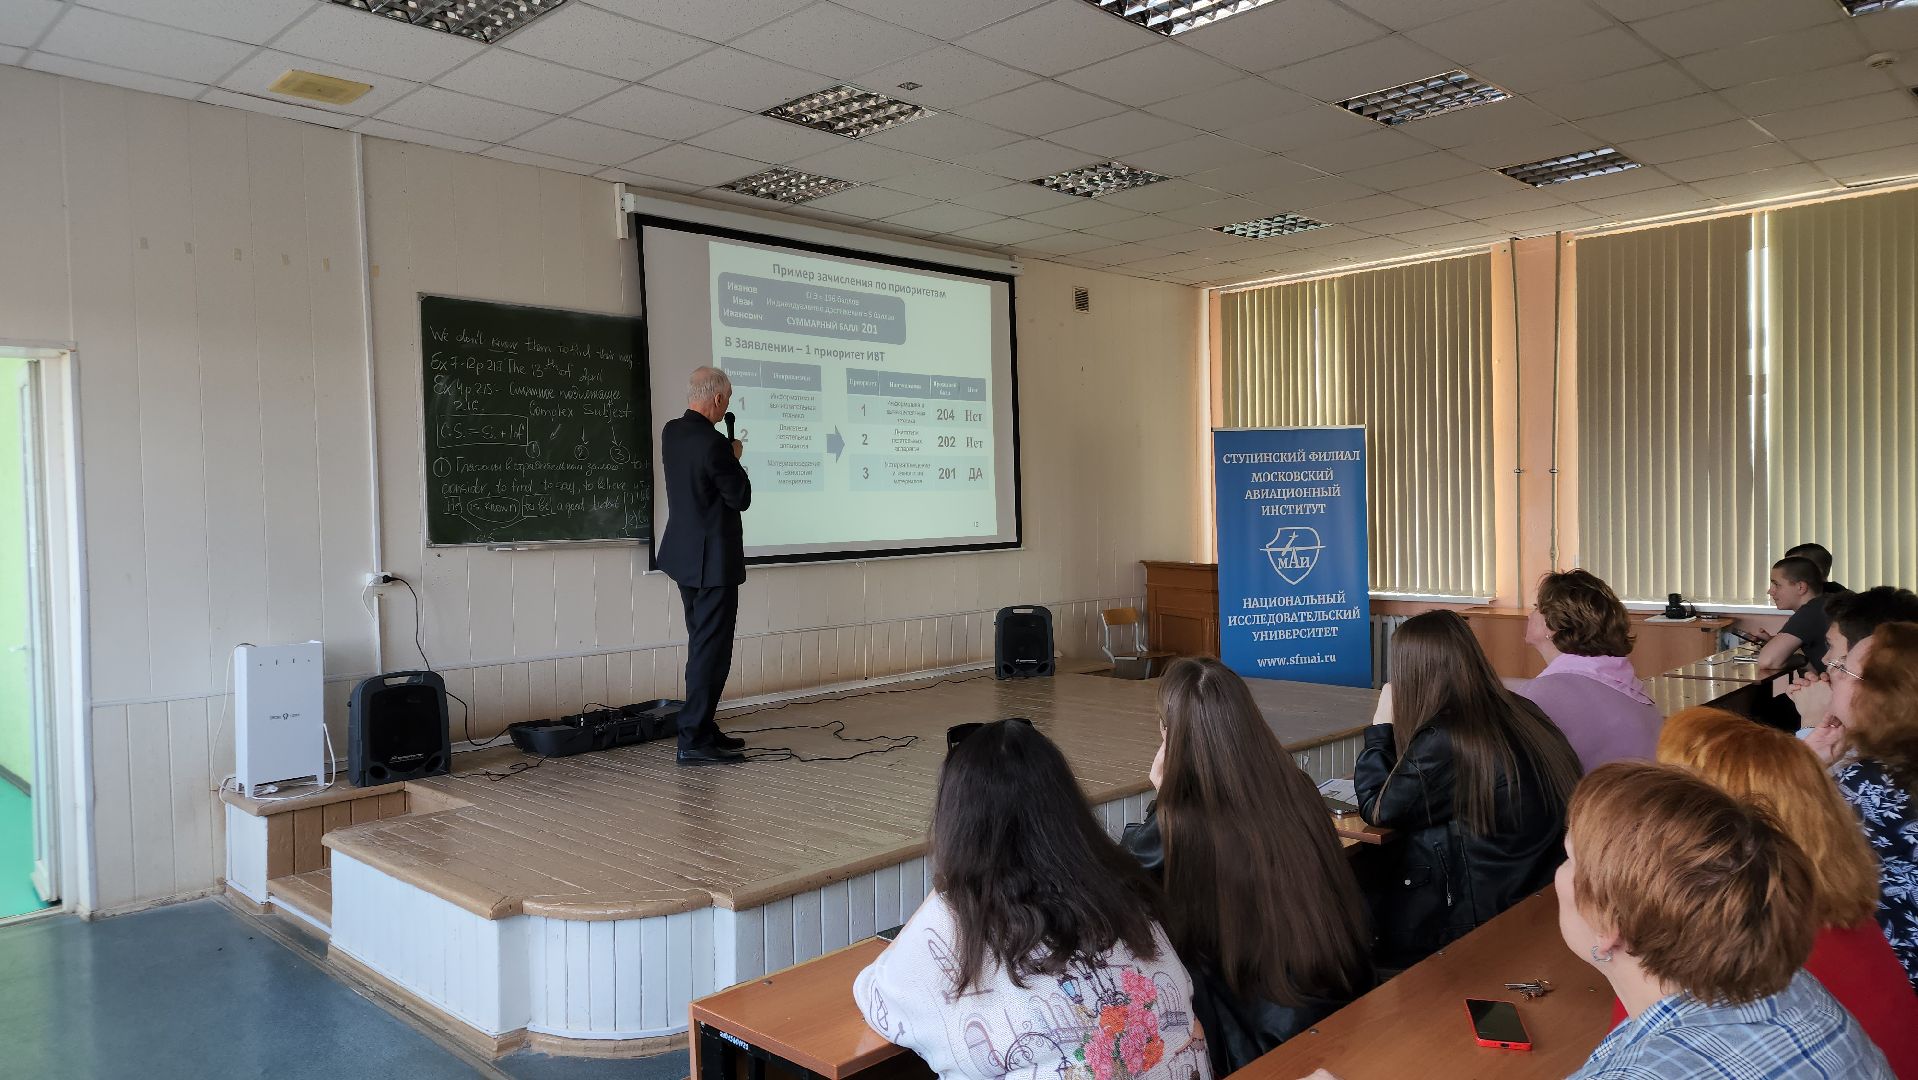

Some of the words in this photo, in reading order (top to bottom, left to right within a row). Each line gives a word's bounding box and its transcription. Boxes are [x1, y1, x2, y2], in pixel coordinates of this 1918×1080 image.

[727, 281, 758, 294] Иванов
[772, 263, 815, 281] Пример
[817, 272, 873, 289] зачисления
[875, 281, 887, 291] по
[888, 283, 947, 299] приоритетам
[732, 295, 753, 306] Иван
[723, 308, 763, 321] Иванович
[786, 316, 838, 330] СУММАРНЫЙ
[839, 323, 858, 332] БАЛЛ
[861, 322, 878, 335] 201
[429, 325, 449, 342] We
[724, 336, 732, 347] В
[735, 337, 794, 354] Заявлении
[805, 344, 811, 355] 1
[813, 347, 865, 360] приоритет
[866, 350, 885, 362] ИВТ
[529, 400, 574, 421] Complex
[738, 397, 746, 411] 1
[860, 403, 866, 417] 1
[936, 408, 955, 421] 204
[965, 409, 983, 422] Нет
[740, 429, 749, 443] 2
[861, 433, 869, 446] 2
[937, 435, 956, 448] 202
[966, 436, 983, 449] Нет
[1223, 448, 1306, 464] СТУПИНСКИЙ
[1308, 450, 1361, 462] ФИЛИАЛ
[862, 467, 870, 480] 3
[938, 467, 957, 480] 201
[968, 467, 983, 482] ДА
[1251, 467, 1334, 483] МОСКОВСКИЙ
[1244, 484, 1341, 501] АВИАЦИОННЫЙ
[1261, 503, 1326, 516] ИНСТИТУТ
[1242, 590, 1346, 610] НАЦИОНАЛЬНЫЙ
[1228, 606, 1361, 627] ИССЛЕДОВАТЕЛЬСКИЙ
[1252, 626, 1339, 642] УНИВЕРСИТЕТ
[1257, 652, 1337, 668] www.sfmai.ru
